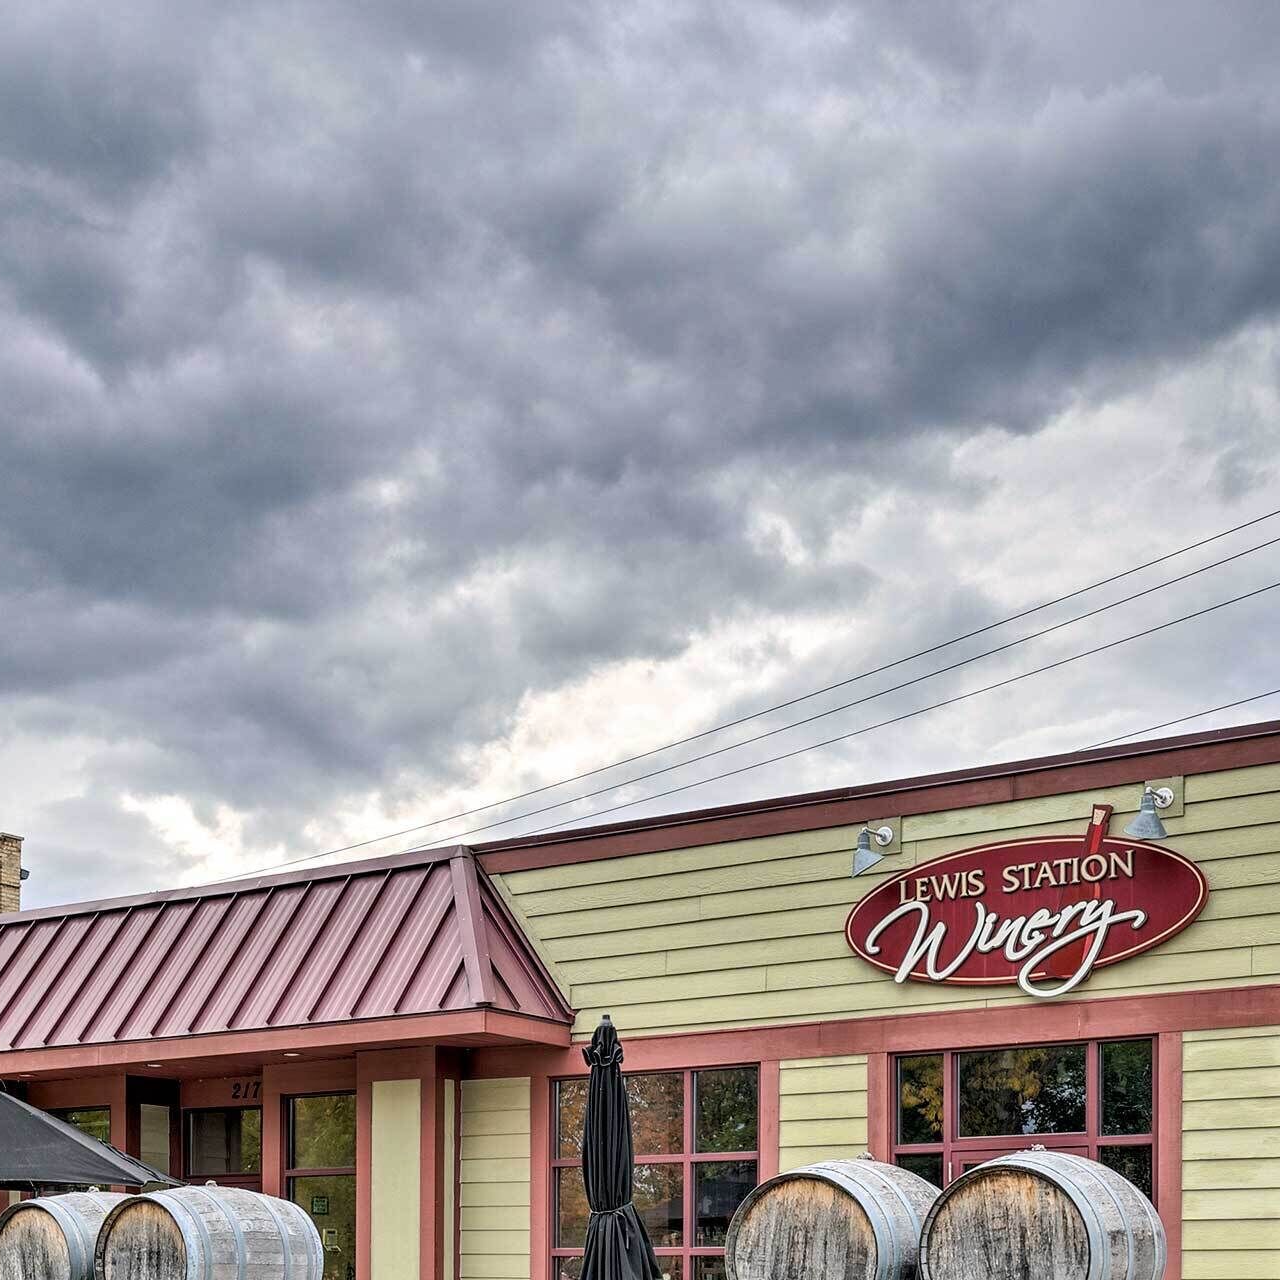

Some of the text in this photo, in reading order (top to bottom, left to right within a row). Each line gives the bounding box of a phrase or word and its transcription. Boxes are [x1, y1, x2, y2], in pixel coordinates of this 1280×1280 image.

[899, 850, 1136, 904] LEWIS STATION
[865, 898, 1148, 998] Winery
[231, 1081, 262, 1099] 217
